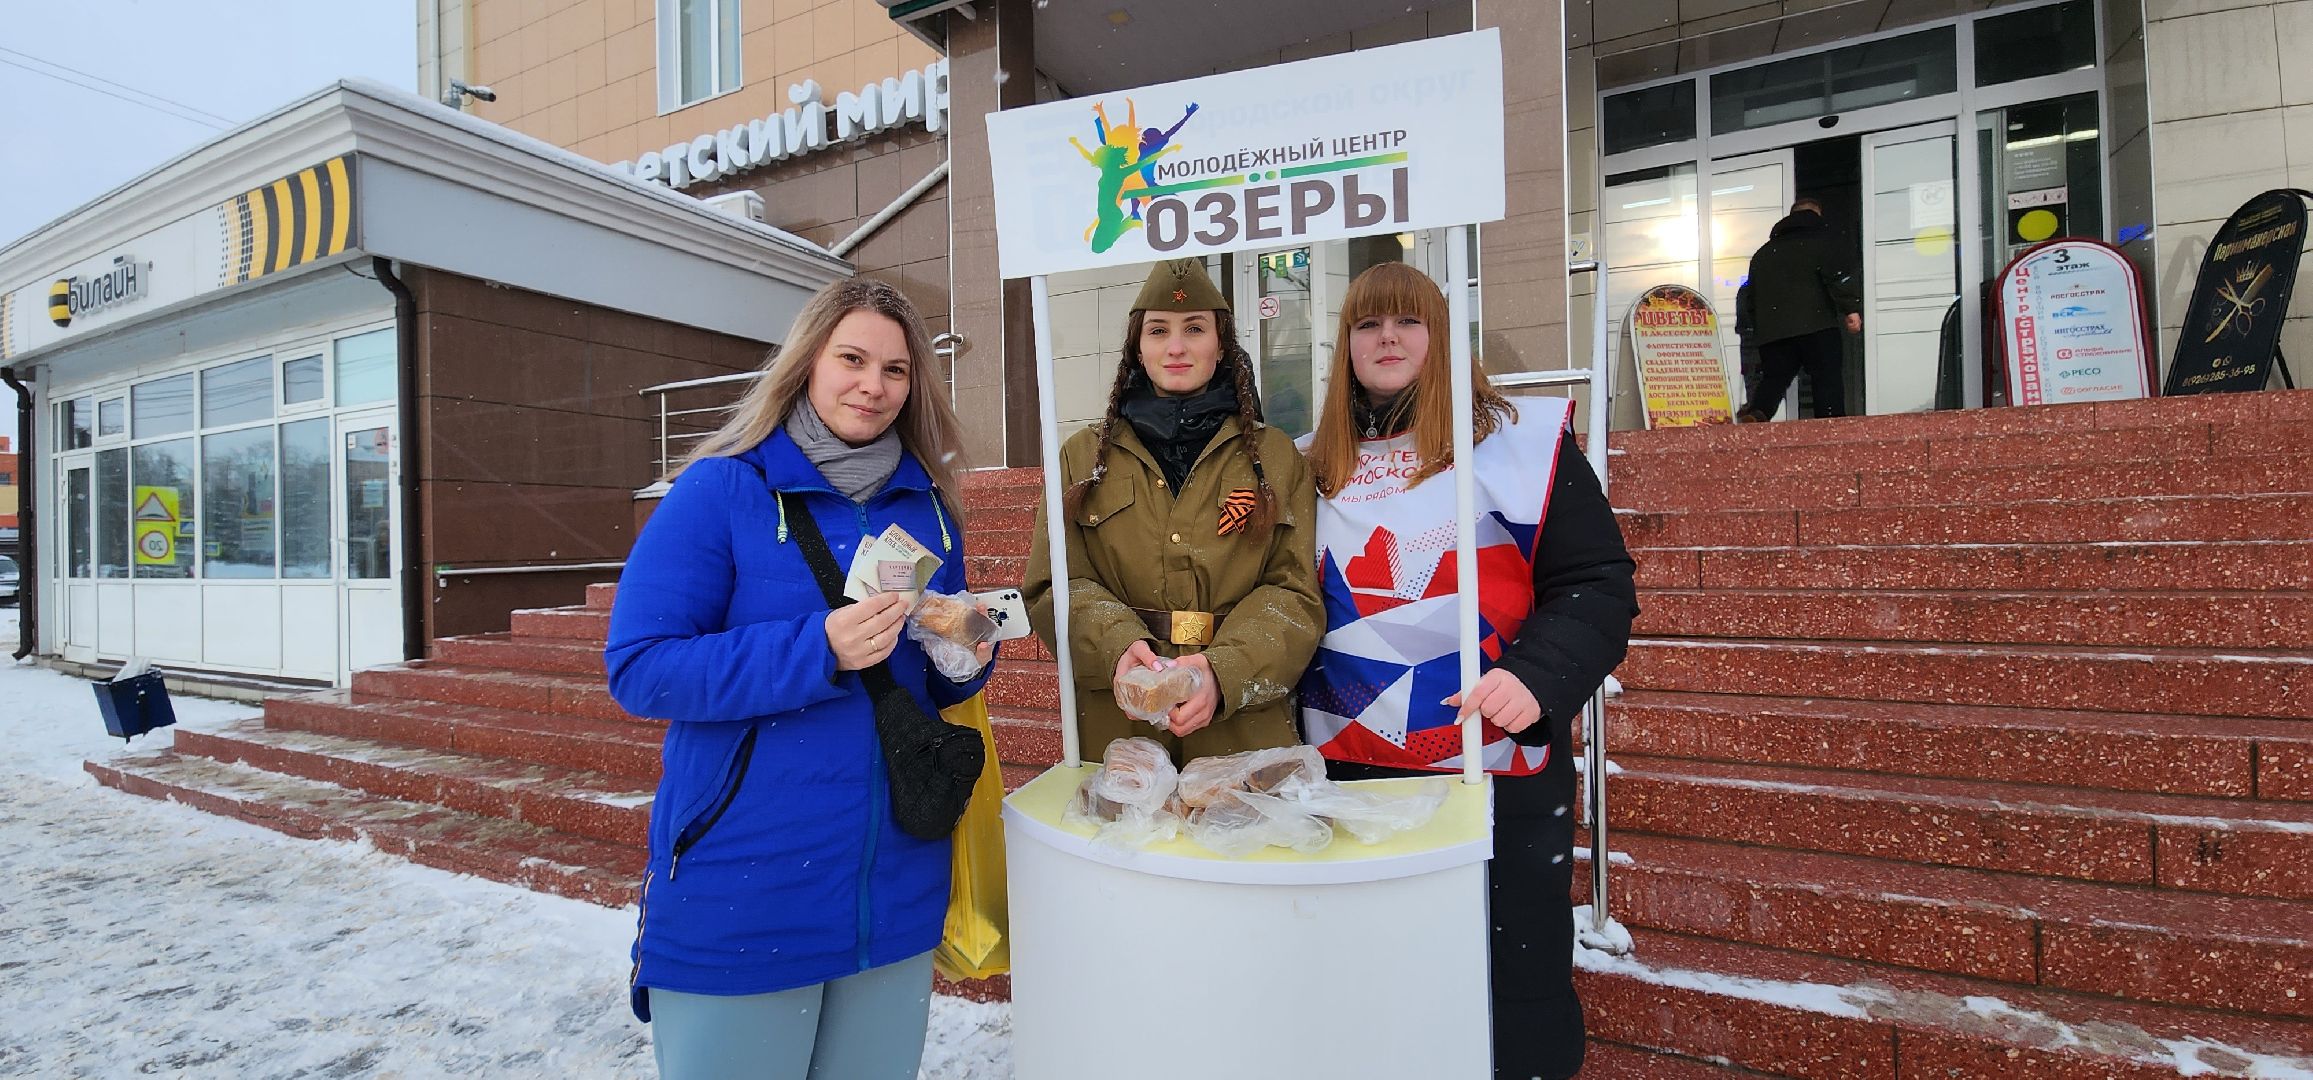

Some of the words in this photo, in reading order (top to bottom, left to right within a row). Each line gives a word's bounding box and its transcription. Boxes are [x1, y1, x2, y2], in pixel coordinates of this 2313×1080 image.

[1157, 137, 1324, 181] МОЛОДЁЖНЫЙ
[1332, 130, 1408, 159] ЦЕНТР
[1147, 168, 1410, 252] ОЗЁРЫ
[2053, 249, 2071, 263] 3
[1641, 310, 1709, 327] ЦВЕТЫ
[2072, 367, 2101, 376] РЕСО
